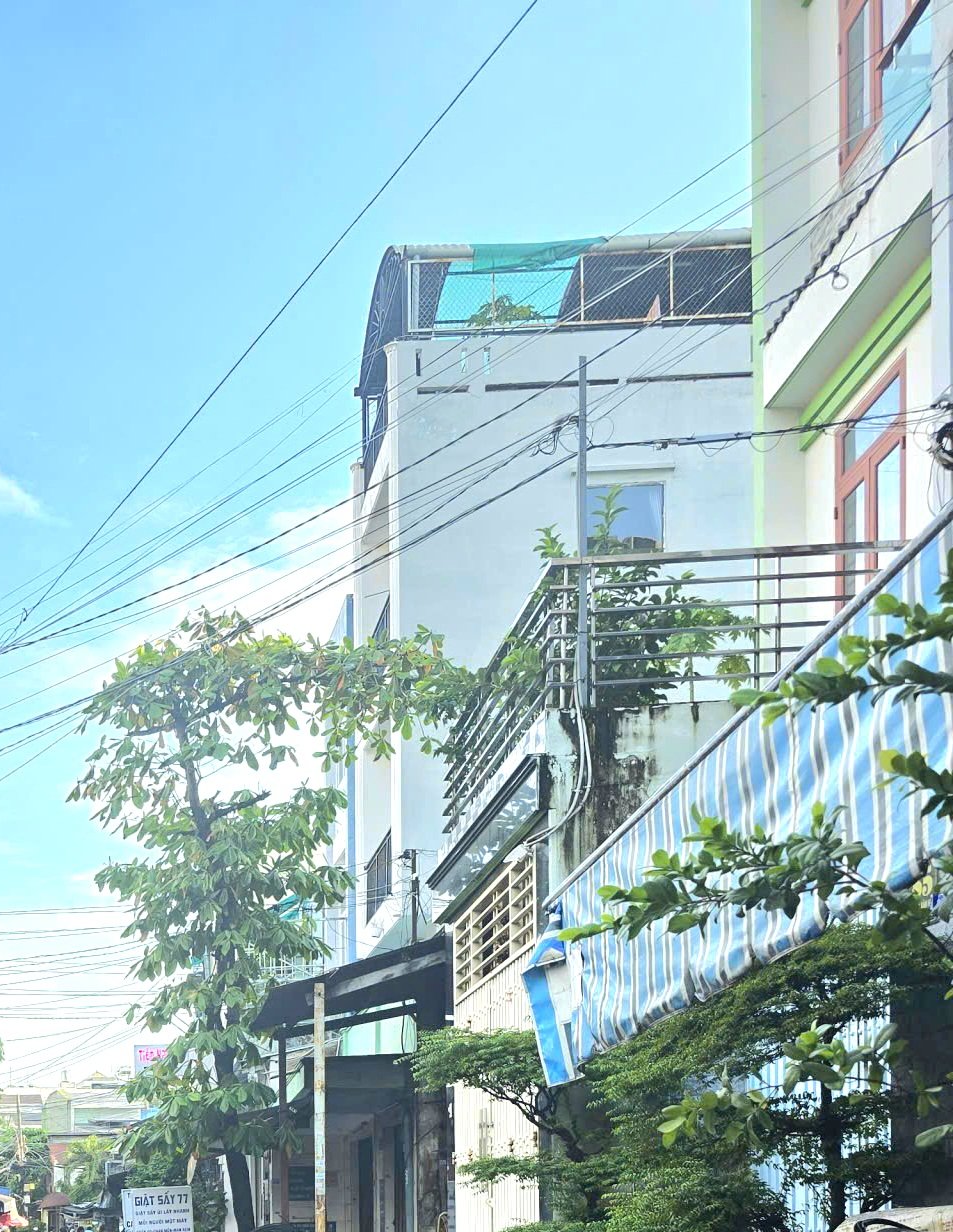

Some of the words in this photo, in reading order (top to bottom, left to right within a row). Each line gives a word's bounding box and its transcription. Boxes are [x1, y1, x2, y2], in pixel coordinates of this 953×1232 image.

[134, 1193, 155, 1207] GIẶT
[157, 1190, 175, 1205] SẤY
[177, 1193, 188, 1204] 77
